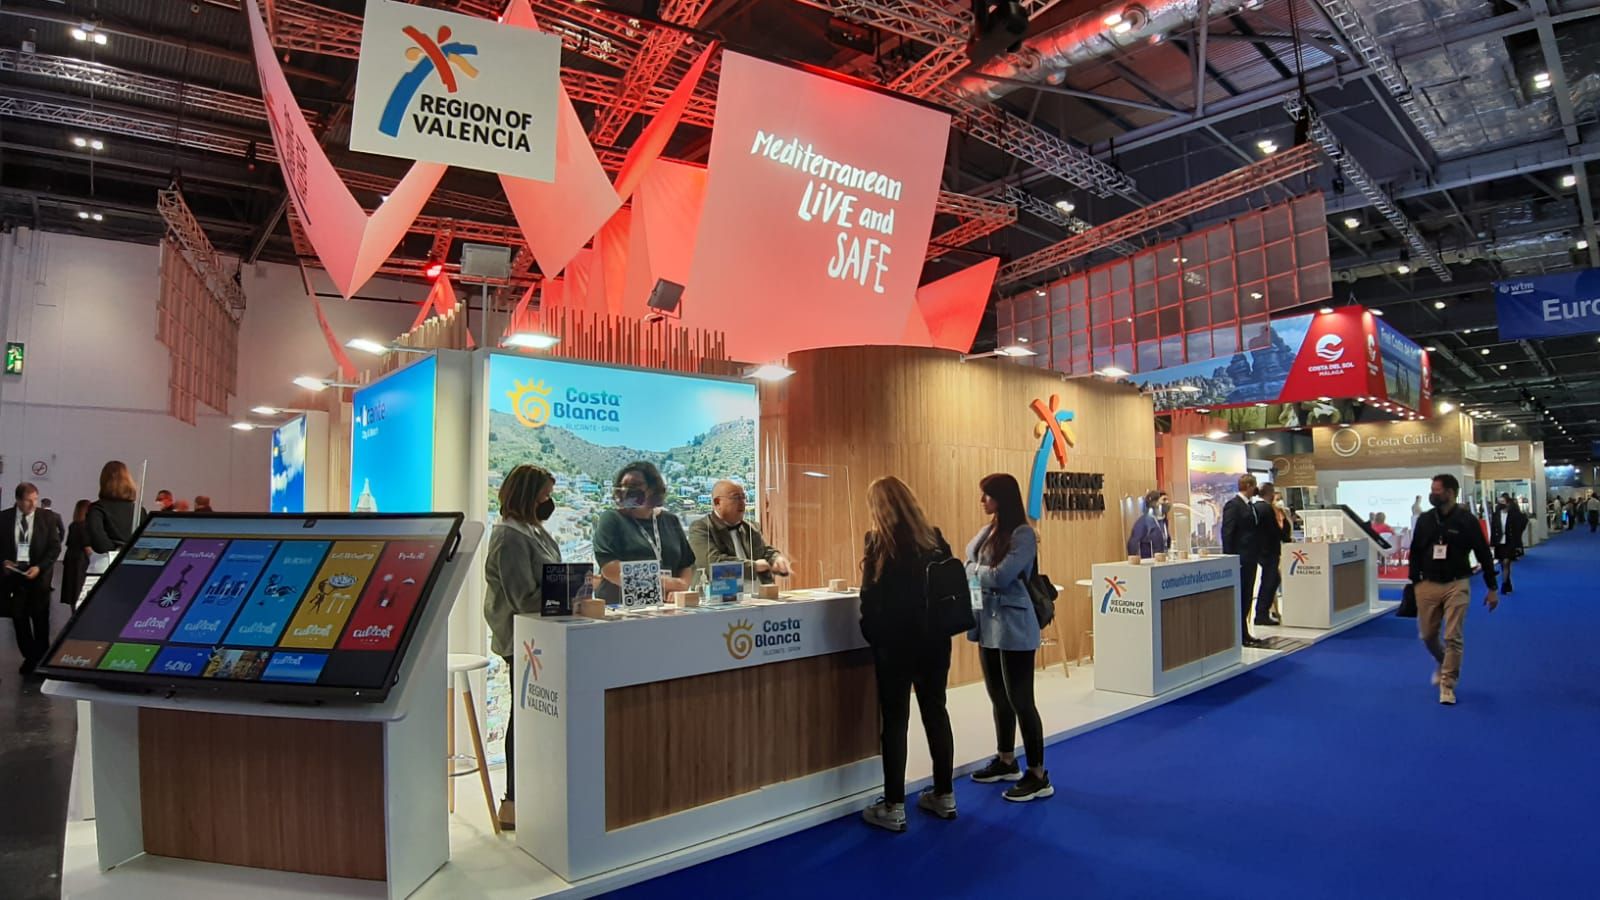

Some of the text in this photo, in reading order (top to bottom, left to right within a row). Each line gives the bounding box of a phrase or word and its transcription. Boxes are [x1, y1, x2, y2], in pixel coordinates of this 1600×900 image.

[419, 94, 532, 131] REGION OF
[412, 113, 531, 153] VALENCIA
[750, 130, 902, 201] Mediterranean
[858, 207, 894, 235] and
[827, 232, 891, 293] SAFE
[1510, 282, 1534, 291] wtm
[1341, 361, 1355, 369] SOL
[566, 386, 620, 406] Costa
[553, 402, 620, 422] Blanca
[1367, 436, 1400, 447] Costa
[1045, 472, 1090, 489] REGION
[1043, 493, 1105, 511] VALENCIA
[1109, 606, 1145, 615] VALENCIA
[1110, 599, 1135, 607] REGION
[763, 617, 800, 633] Costa
[755, 632, 801, 648] Blanca
[528, 683, 558, 702] REGION OF
[527, 696, 559, 718] VALENCIA
